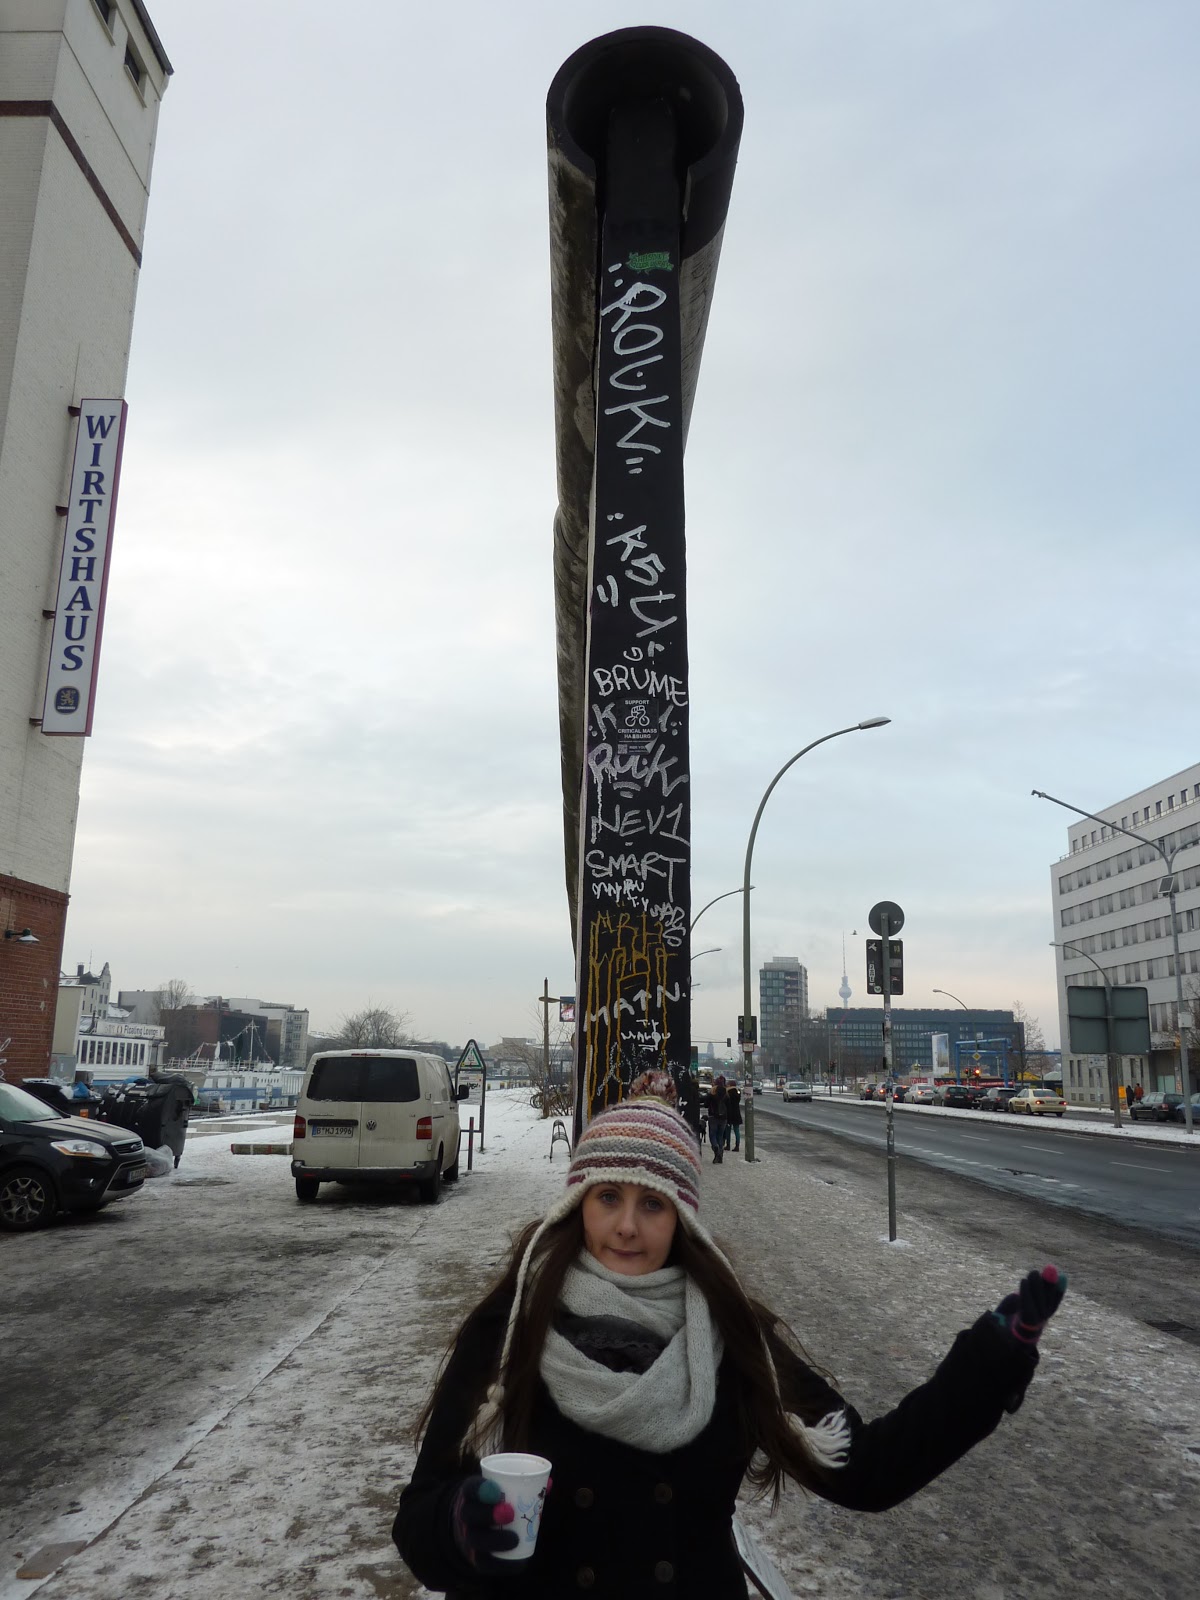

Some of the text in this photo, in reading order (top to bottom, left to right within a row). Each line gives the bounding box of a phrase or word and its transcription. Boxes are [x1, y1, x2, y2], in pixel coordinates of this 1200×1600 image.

[61, 415, 116, 671] WIRTSHAUS
[593, 664, 689, 707] BRUME
[586, 849, 687, 903] SMART
[124, 1024, 143, 1036] Floating
[143, 1026, 159, 1036] Lounge
